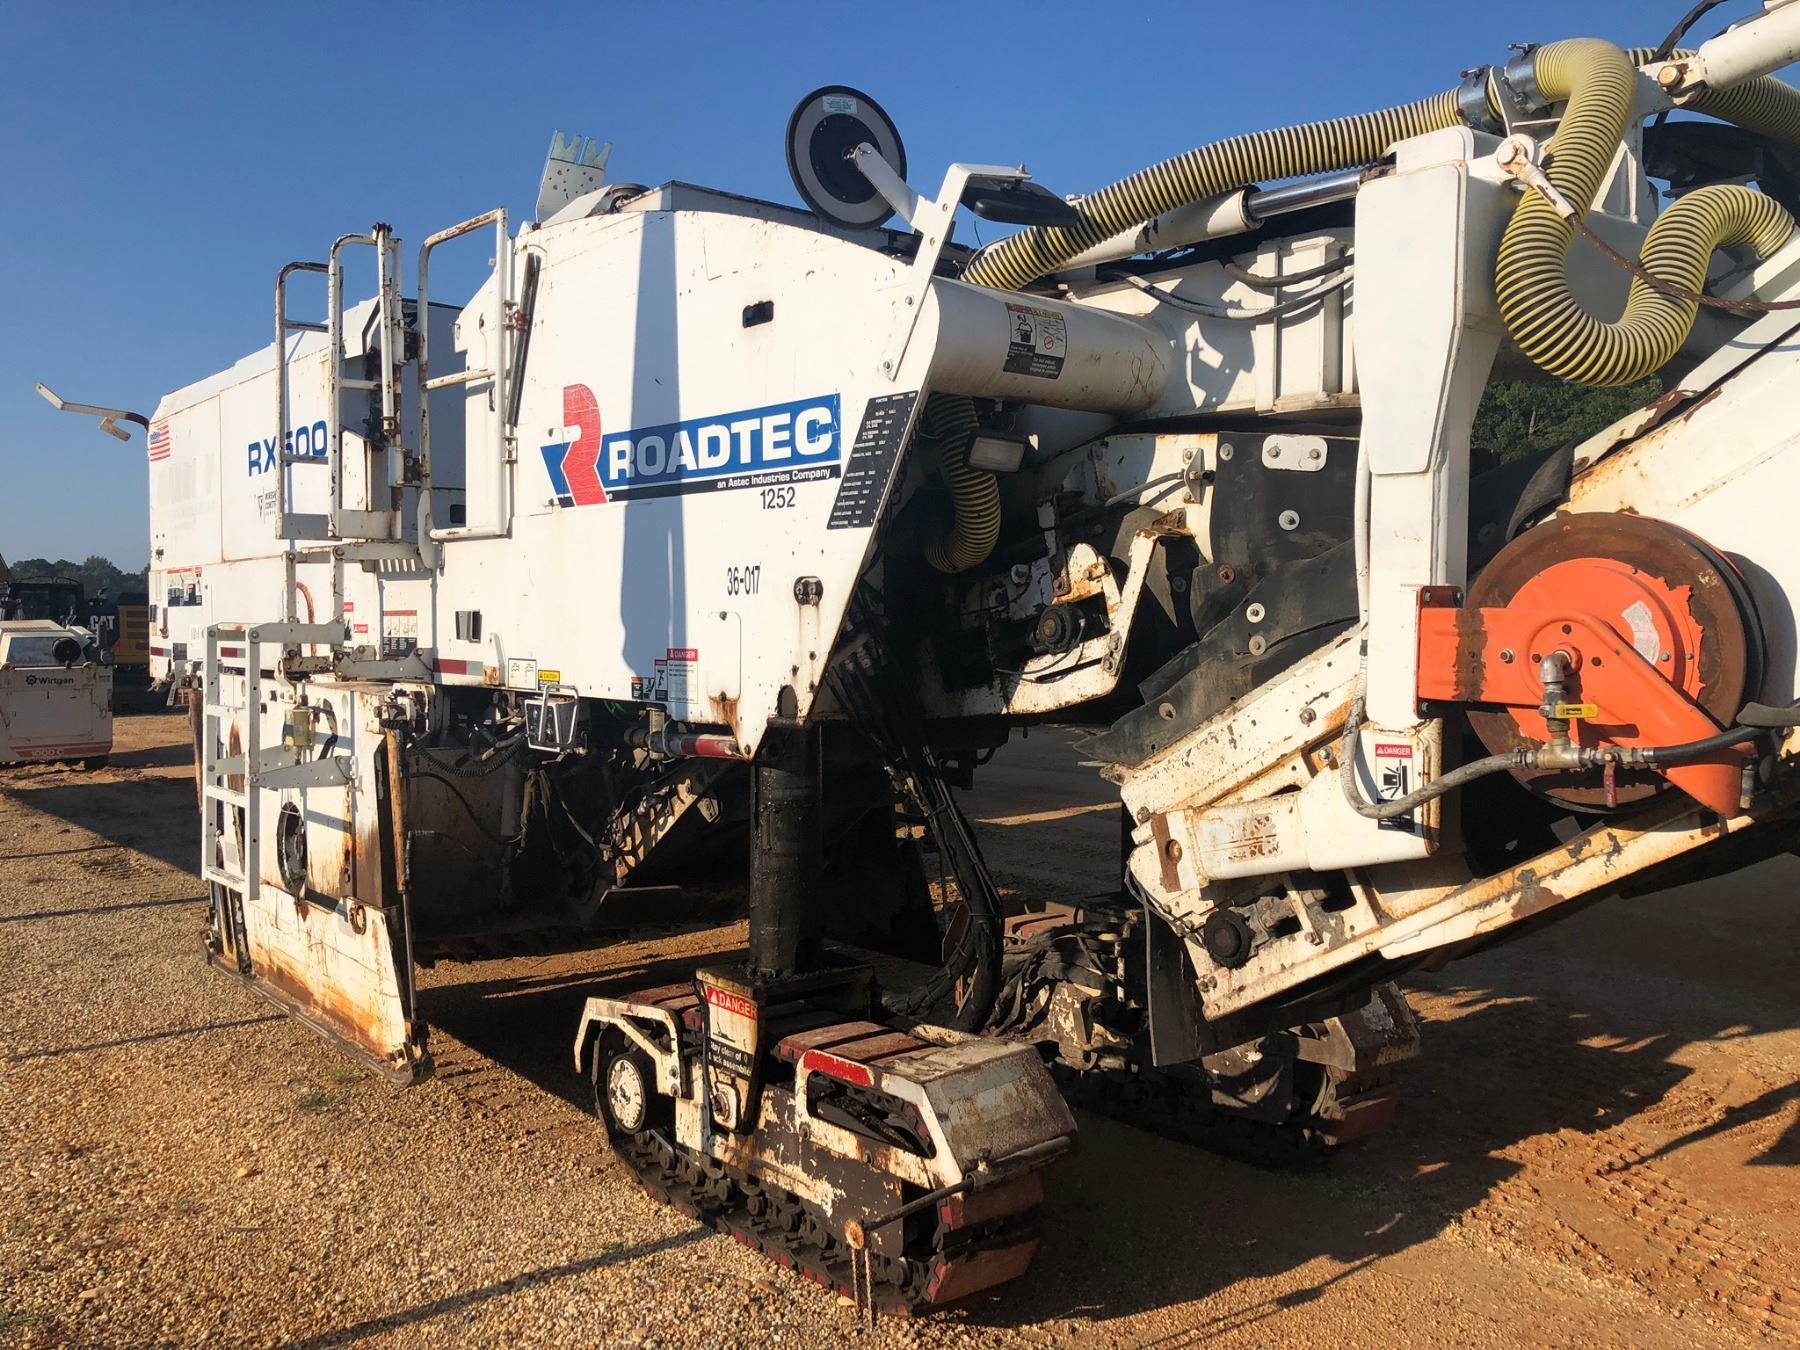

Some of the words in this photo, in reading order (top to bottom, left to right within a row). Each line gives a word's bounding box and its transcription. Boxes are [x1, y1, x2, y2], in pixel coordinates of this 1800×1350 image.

[608, 407, 833, 480] ROADTEC
[717, 477, 727, 488] an
[728, 477, 750, 488] Astec
[751, 472, 790, 485] Industries
[792, 468, 831, 482] Company
[759, 486, 796, 510] 1252
[727, 565, 761, 596] 36-017
[90, 615, 115, 630] CAT
[674, 650, 696, 659] DANGER
[38, 676, 74, 687] Wirtgen
[1384, 746, 1411, 755] DANGER
[719, 993, 758, 1018] DANGER
